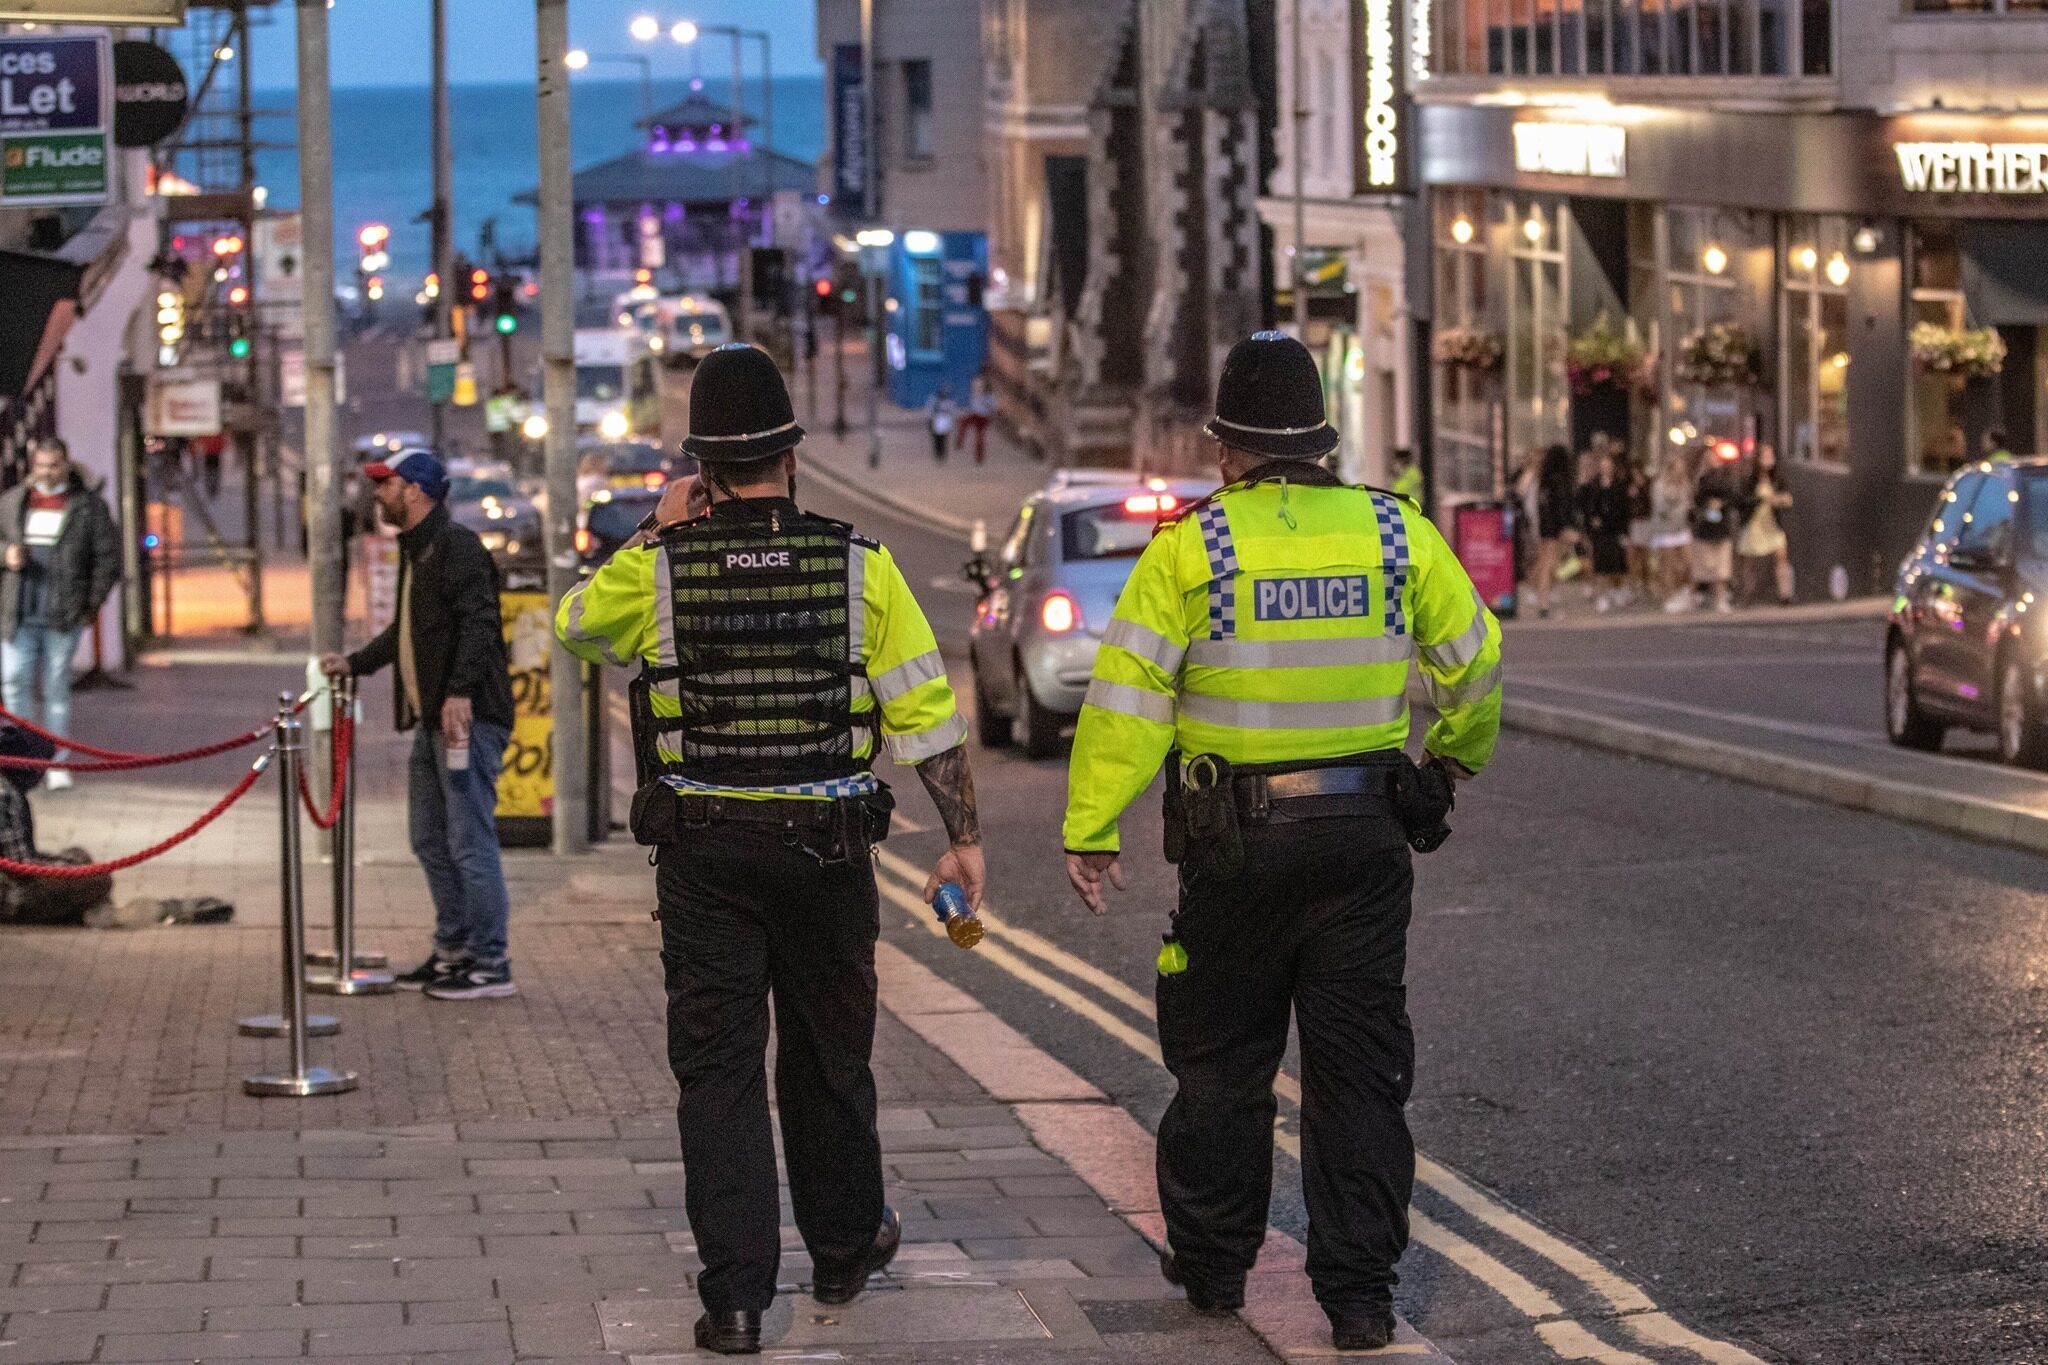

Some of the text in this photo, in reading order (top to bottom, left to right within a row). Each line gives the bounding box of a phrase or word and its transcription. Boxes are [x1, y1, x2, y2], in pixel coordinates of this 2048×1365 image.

[0, 77, 76, 115] Let
[1893, 142, 2048, 193] WETHER
[726, 552, 790, 569] POLICE
[1259, 577, 1364, 619] POLICE
